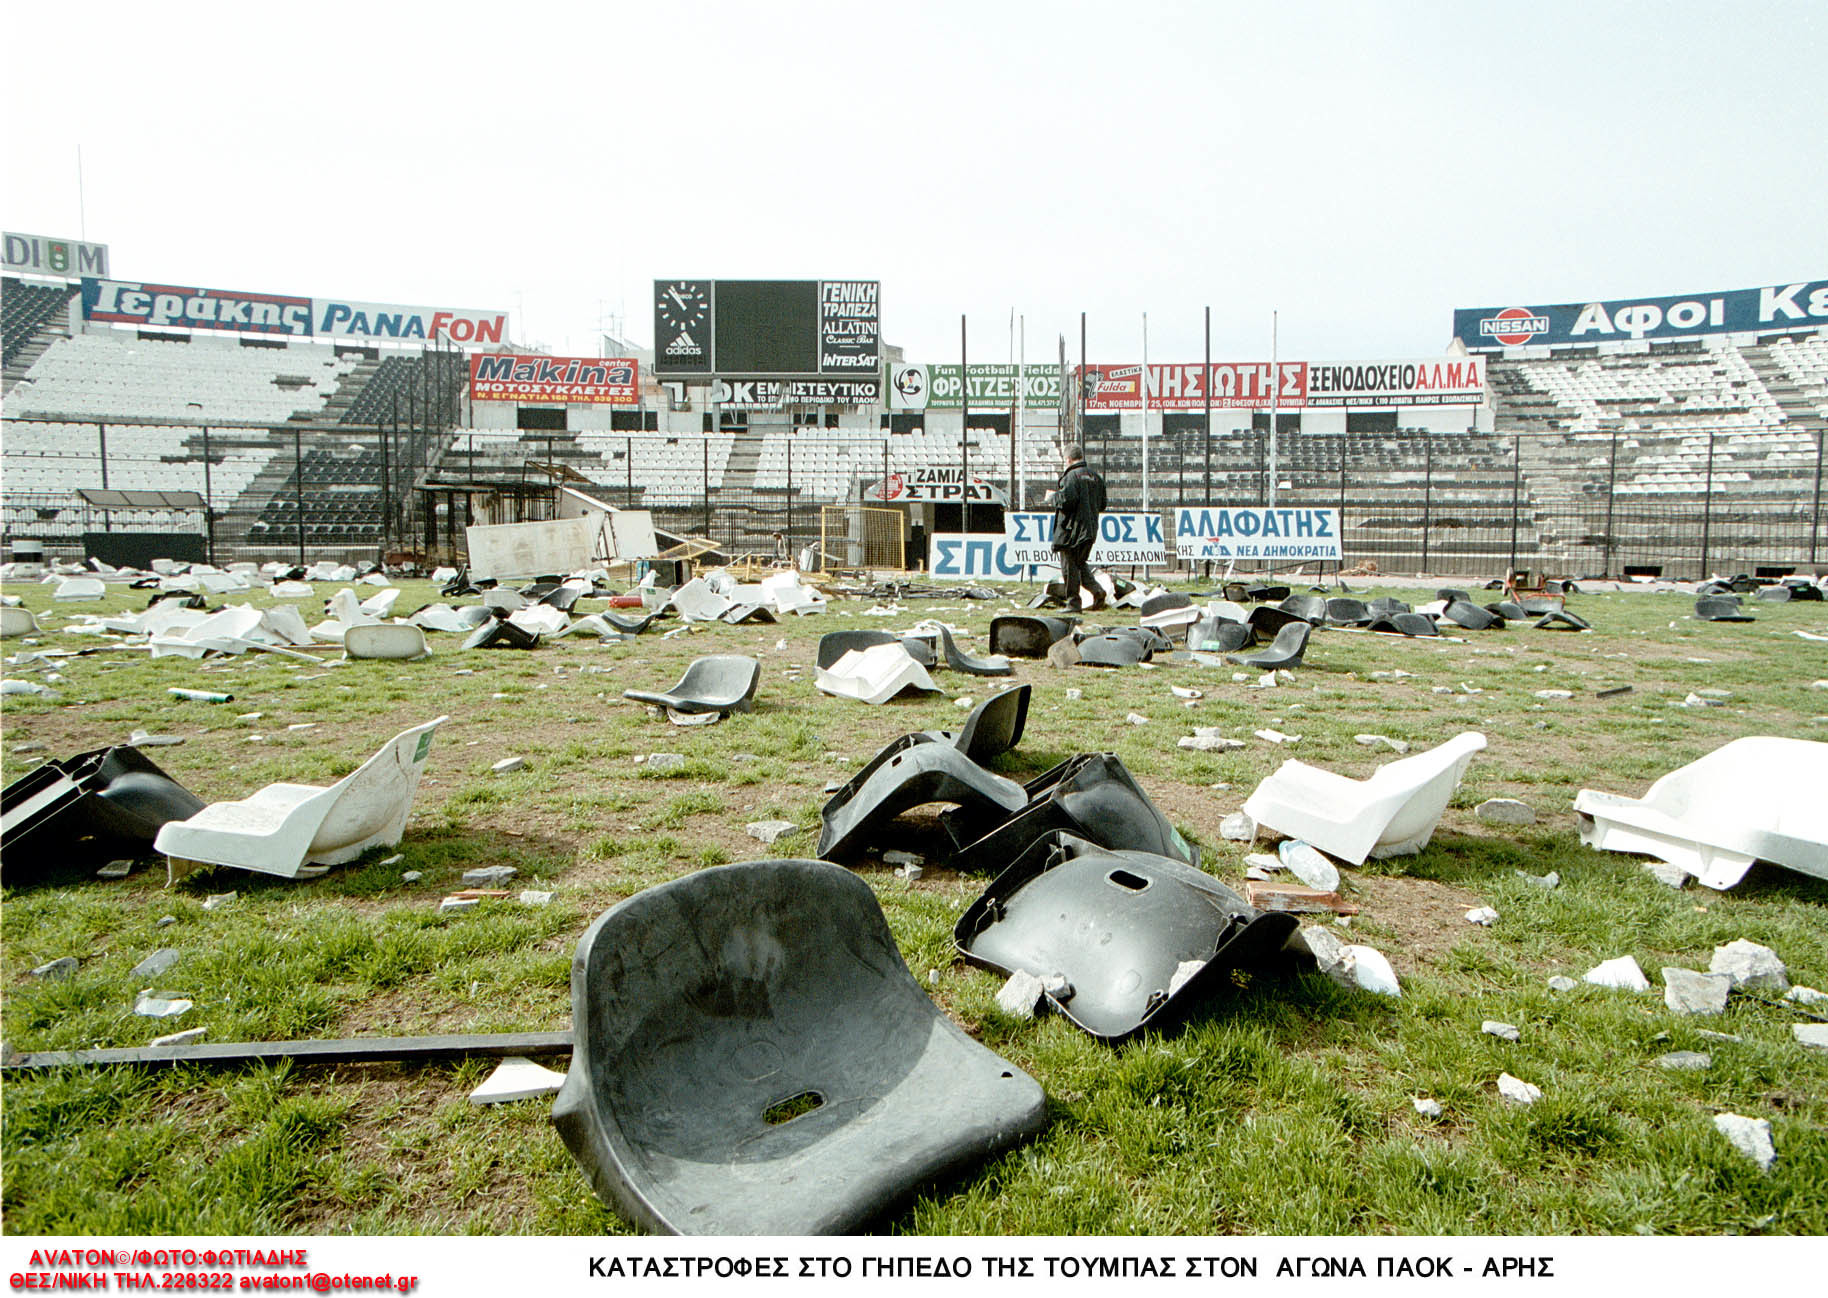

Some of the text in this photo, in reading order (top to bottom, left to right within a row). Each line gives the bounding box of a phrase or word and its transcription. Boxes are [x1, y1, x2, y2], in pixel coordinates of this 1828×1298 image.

[822, 282, 877, 303] ΓΕΝΙΚΗ
[91, 280, 310, 336] Γεράκης
[823, 303, 877, 317] ΤΡΑΠΕΖΑ
[1570, 298, 1724, 339] Αφοι
[822, 321, 877, 335] ALLATINI
[1483, 319, 1545, 334] NISSAN
[665, 345, 702, 355] adidas
[599, 359, 631, 368] center
[935, 365, 956, 375] Fun
[966, 364, 1013, 375] Football
[1111, 366, 1142, 377] ΕΛΑΣΤΙΚΑ
[1310, 361, 1483, 391] ΞΕΝΟΔΟΧΕΙΟ Α.Λ.Μ.Α.
[475, 382, 634, 396] ΜΟΤΟΣΥΚΛΕΤΕΣ
[756, 382, 876, 396] ΕΜΙΣΤΕΥΤΙΚΟ
[1097, 381, 1127, 392] Fulda
[493, 393, 551, 401] ΕΓΝΑΤΙΑ
[1177, 510, 1334, 537] ΑΛΑΦΑΤΗΣ
[1014, 550, 1031, 562] ΥΠ.
[1236, 545, 1259, 556] ΝΕΑ
[1263, 545, 1337, 557] ΔΗΜΟΚΡΑΤΙΑ
